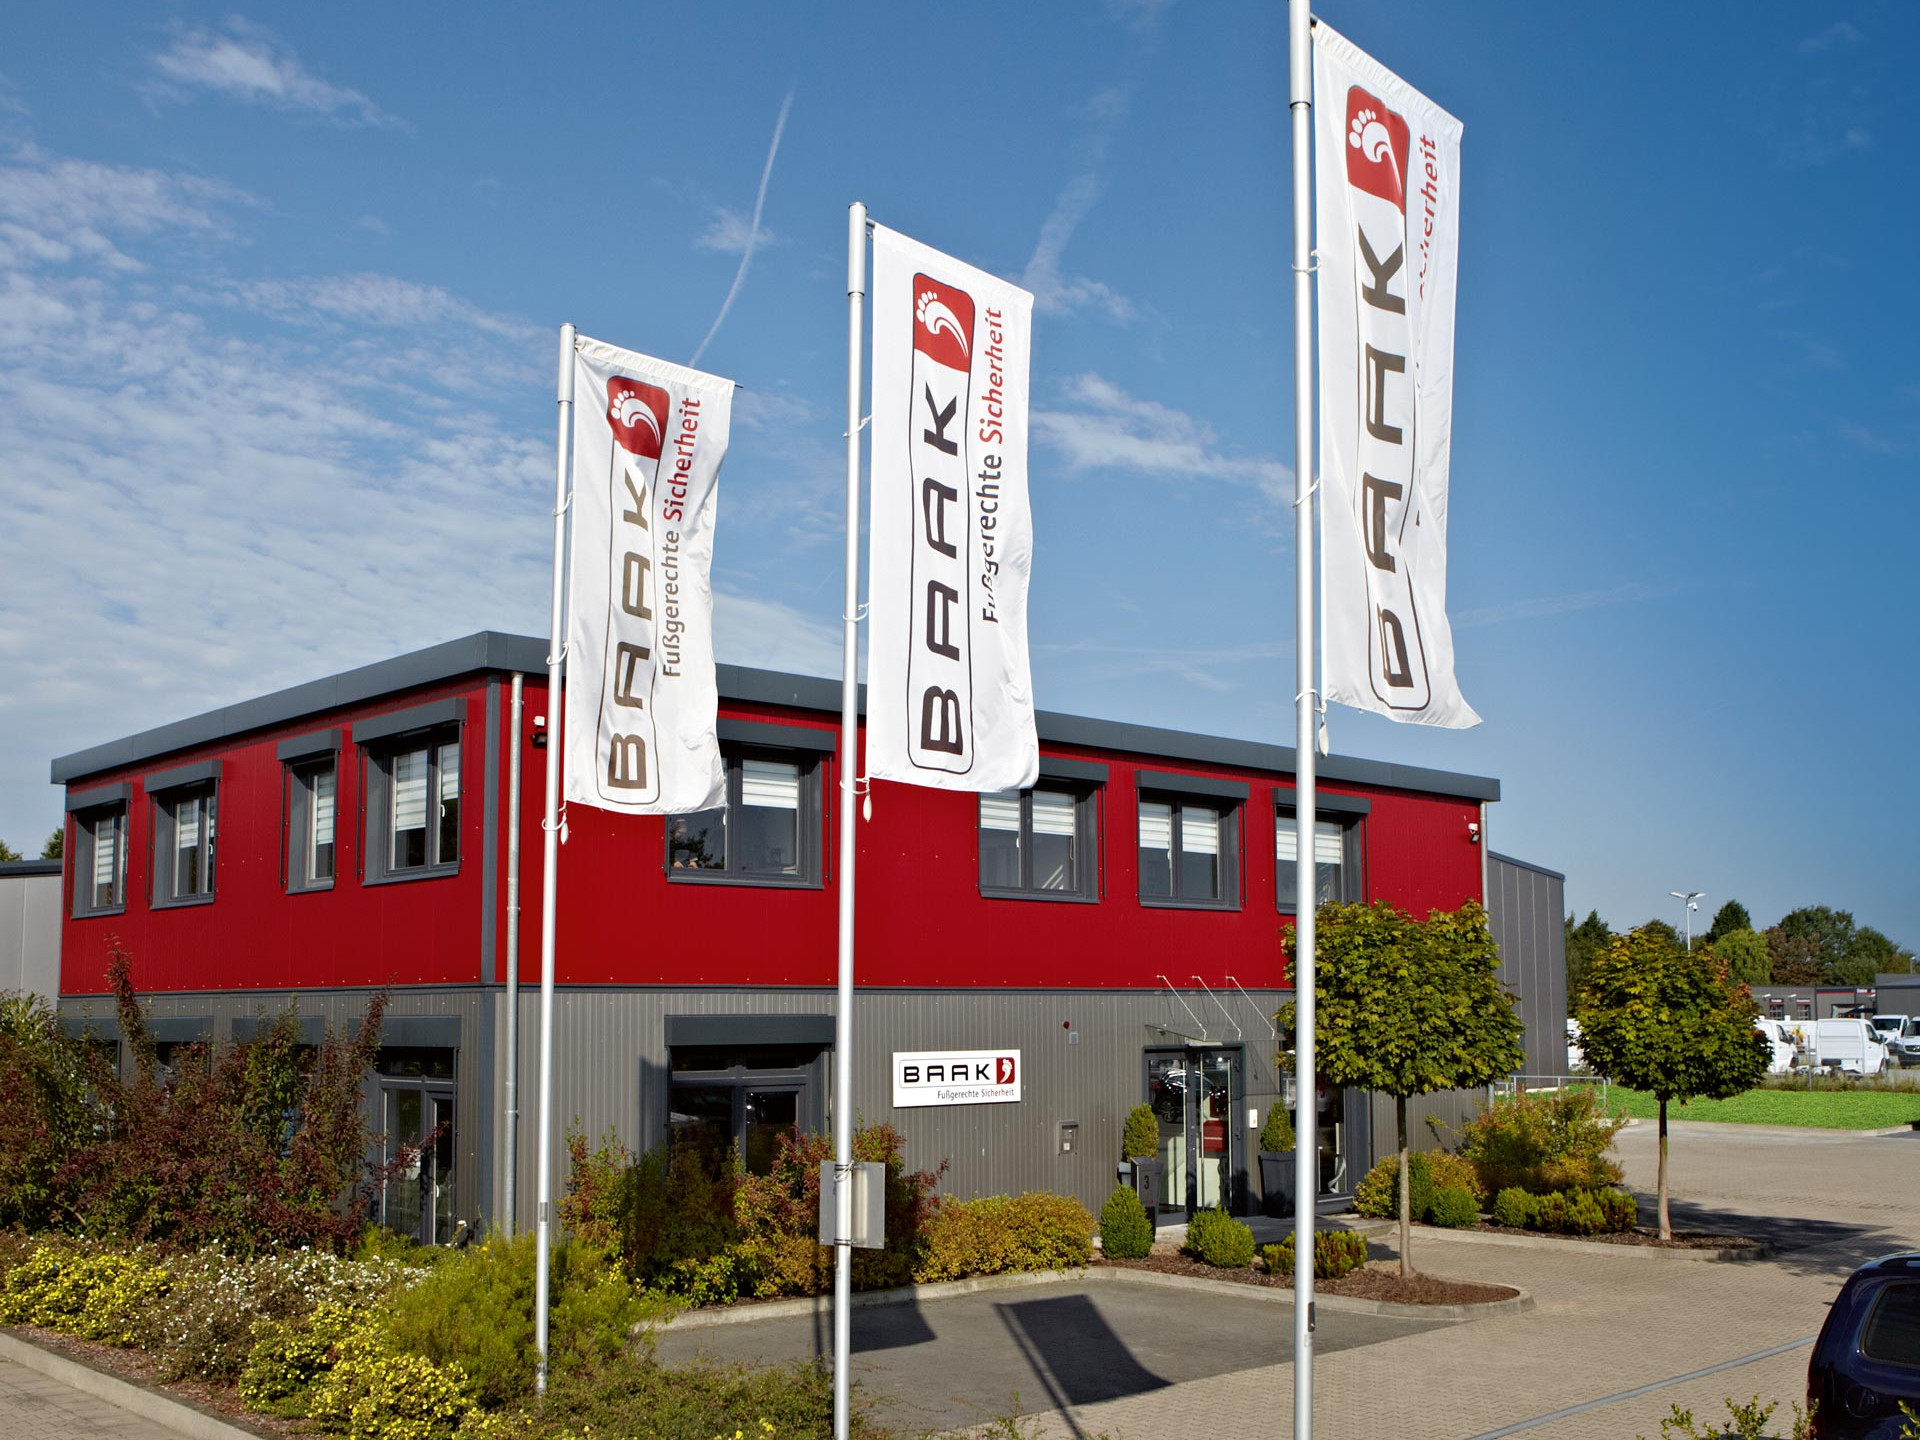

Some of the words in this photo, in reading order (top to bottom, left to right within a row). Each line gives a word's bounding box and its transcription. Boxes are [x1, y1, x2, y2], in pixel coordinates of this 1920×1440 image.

[1419, 134, 1438, 301] erheit
[979, 306, 1003, 445] Sicherheit
[663, 397, 701, 522] Sicherheit
[660, 530, 685, 677] Fußgerechte
[920, 381, 964, 757] BAAK
[975, 454, 1003, 624] Fußgerechte
[607, 468, 653, 790] BAAK
[903, 1063, 991, 1083] BAAK
[937, 1089, 979, 1101] Fußgerechte
[981, 1088, 1015, 1098] Sicherheit
[1144, 1174, 1150, 1190] 3
